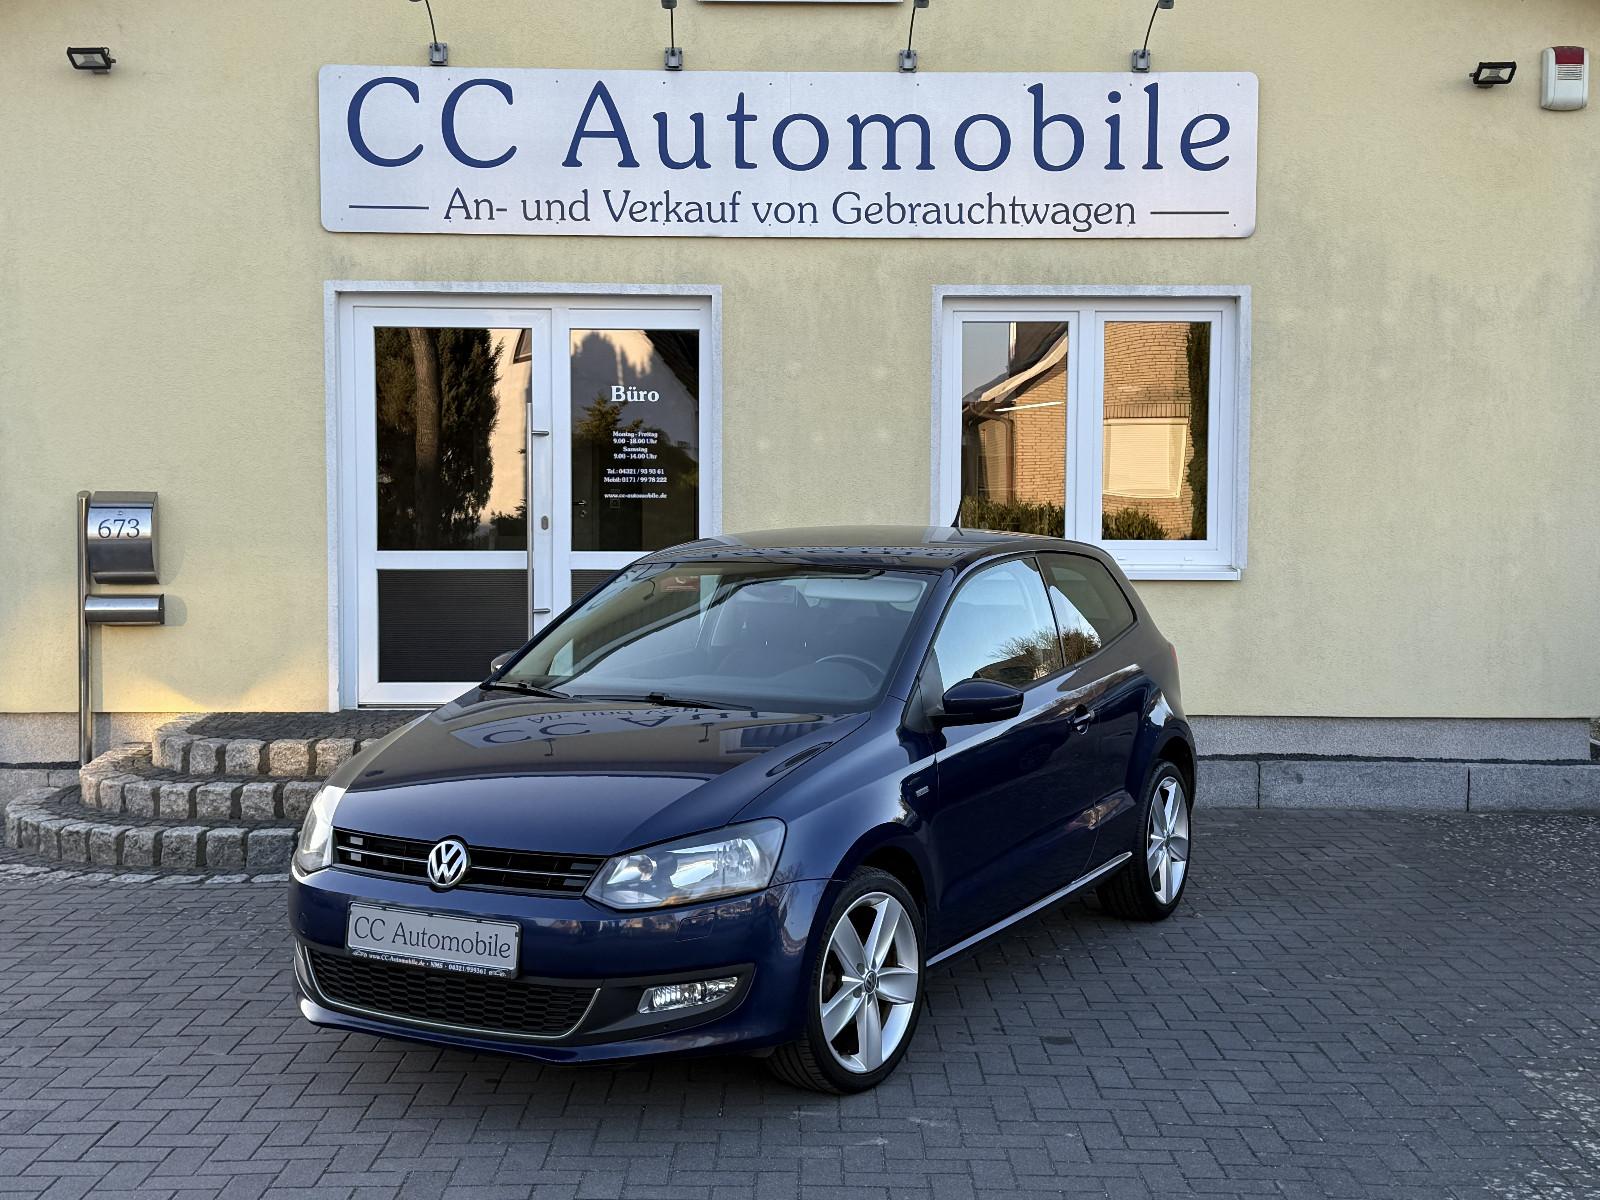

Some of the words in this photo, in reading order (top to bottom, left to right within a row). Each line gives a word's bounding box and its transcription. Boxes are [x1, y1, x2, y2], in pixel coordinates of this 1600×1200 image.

[347, 77, 518, 168] CC
[561, 81, 1231, 172] Automobile
[444, 188, 508, 222] An-
[521, 189, 591, 223] und
[603, 189, 742, 224] Verkauf
[751, 203, 819, 226] von
[832, 191, 1136, 233] Gebrauchtwagen
[611, 385, 660, 402] Büro
[612, 430, 635, 438] Montag
[638, 430, 658, 438] Freitag
[97, 518, 141, 539] 673
[428, 839, 467, 888] VW
[354, 916, 386, 942] CC
[391, 921, 511, 959] Automobile
